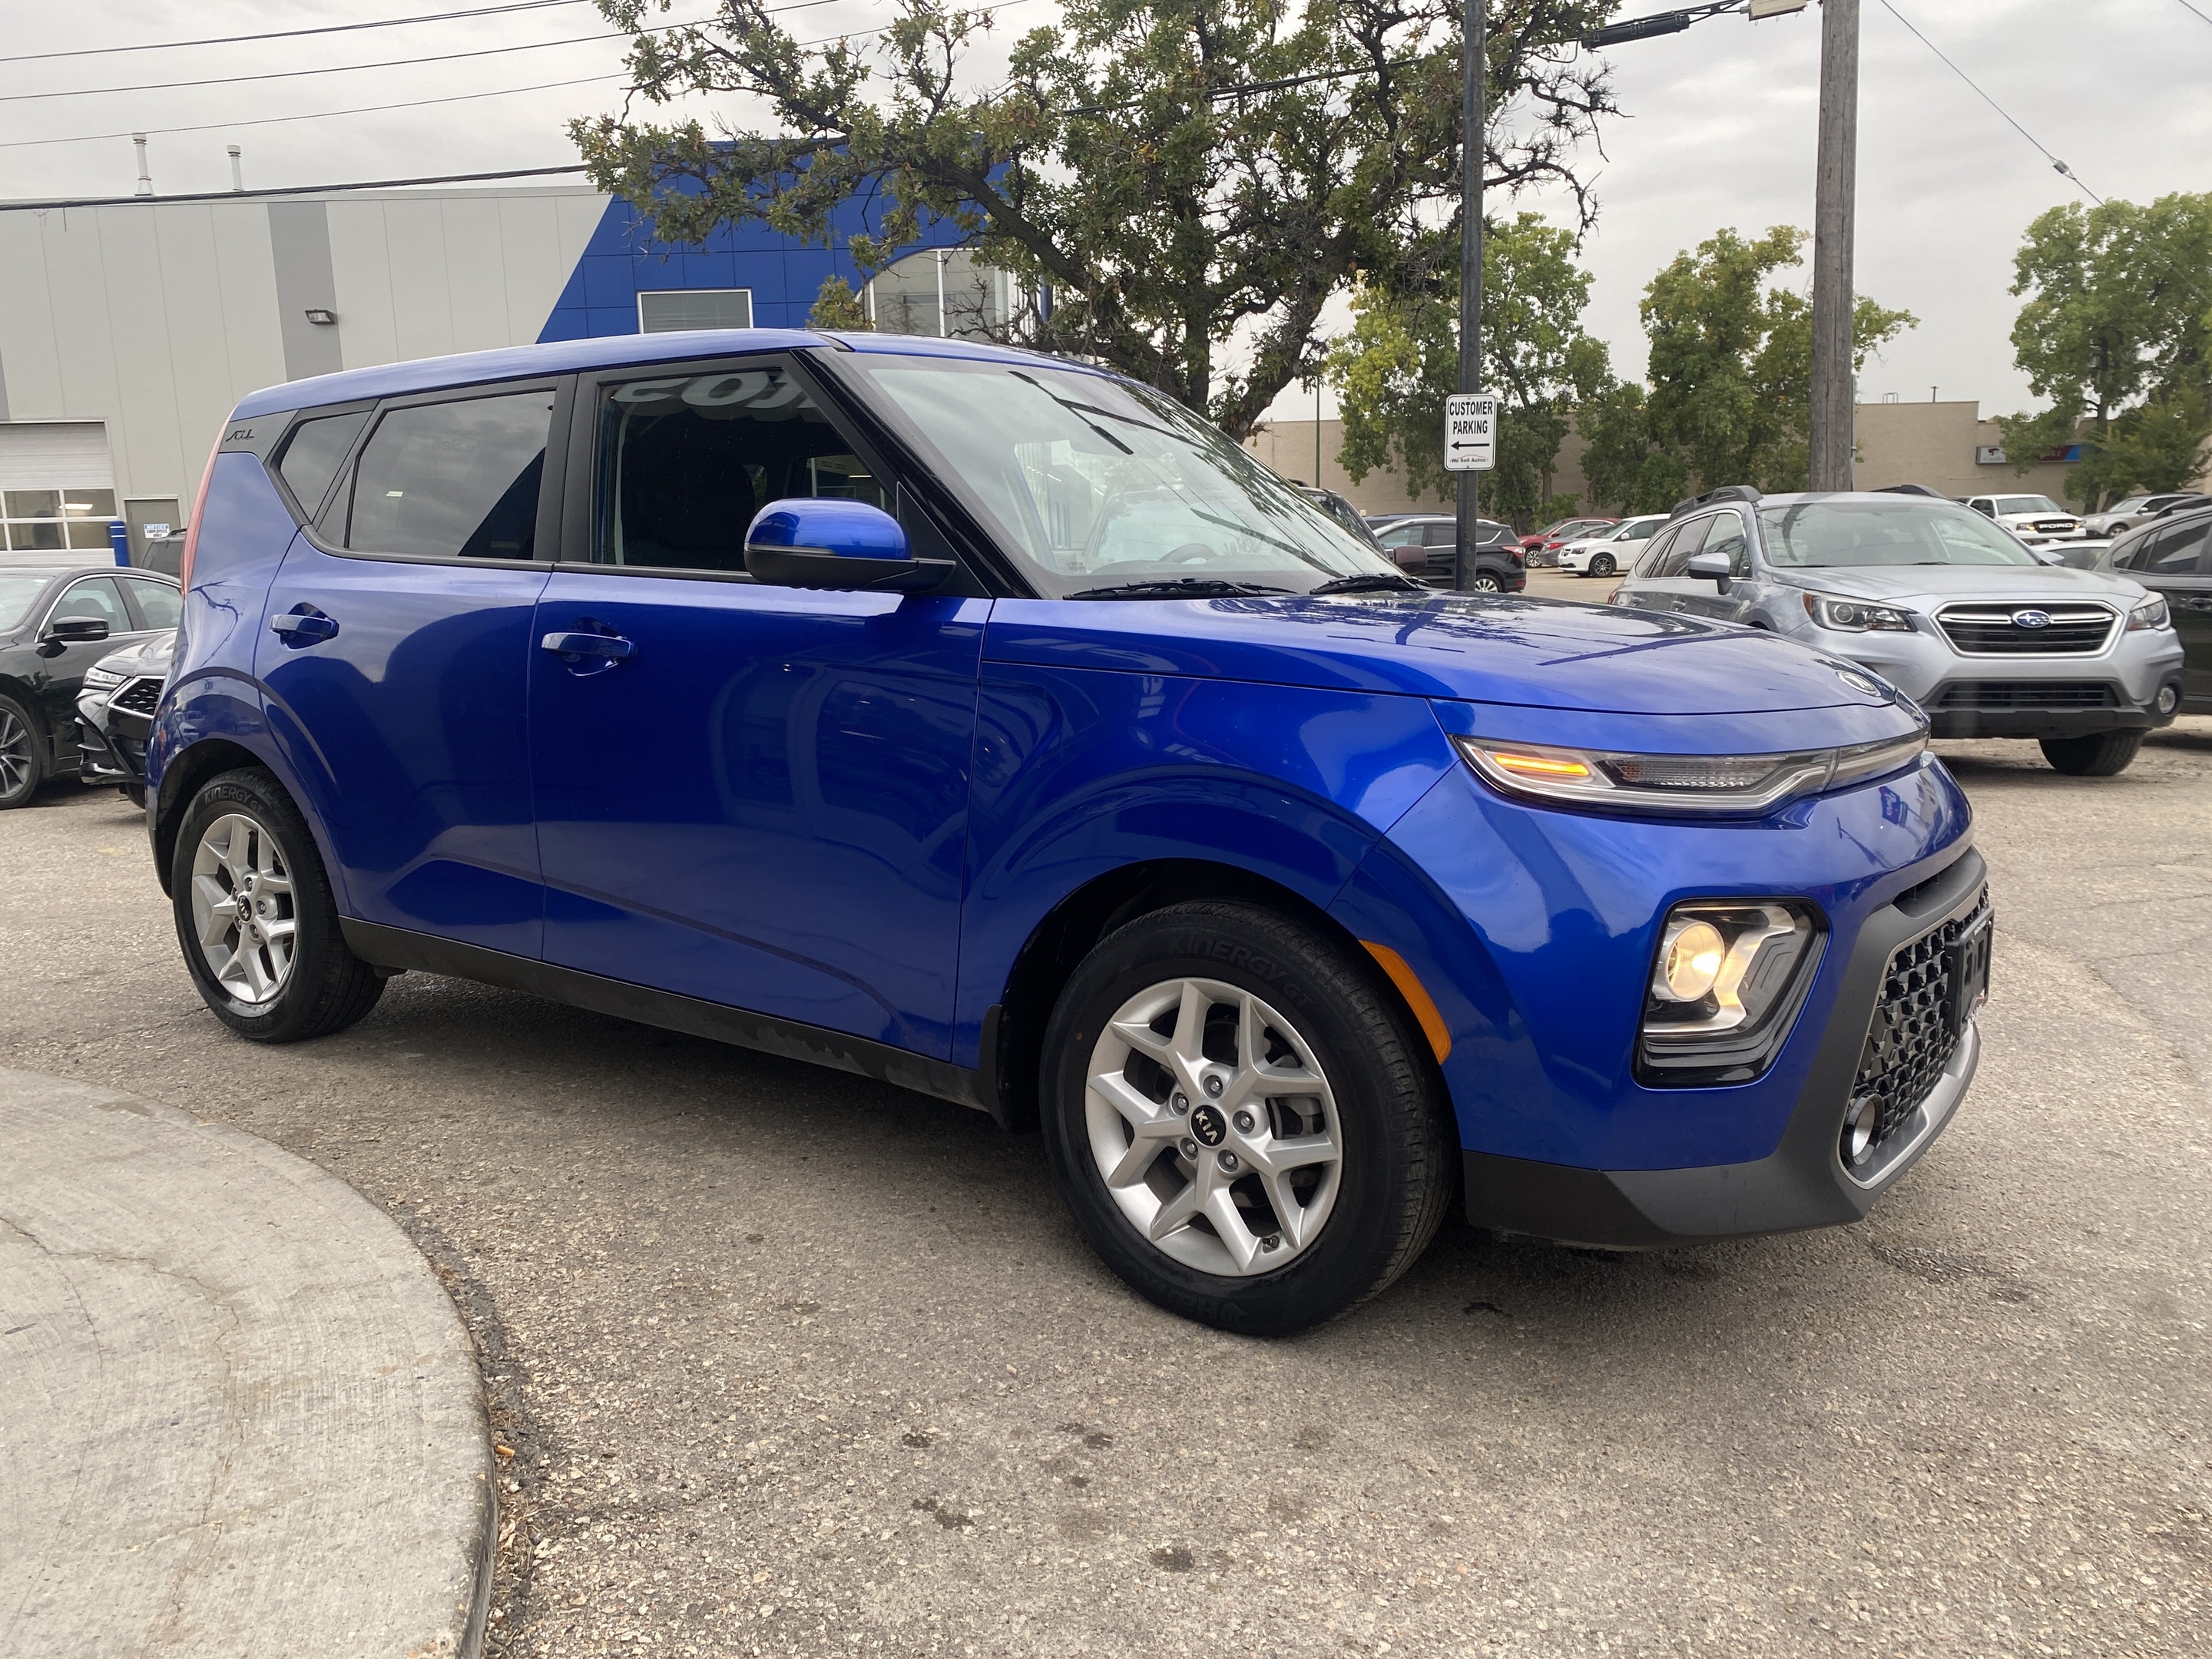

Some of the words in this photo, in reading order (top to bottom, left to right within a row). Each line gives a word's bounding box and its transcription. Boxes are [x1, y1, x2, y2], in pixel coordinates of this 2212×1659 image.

[1449, 401, 1493, 416] CUSTOMER
[1452, 420, 1488, 435] PARKING
[1283, 983, 1316, 1008] GT
[1195, 1110, 1218, 1143] KIA
